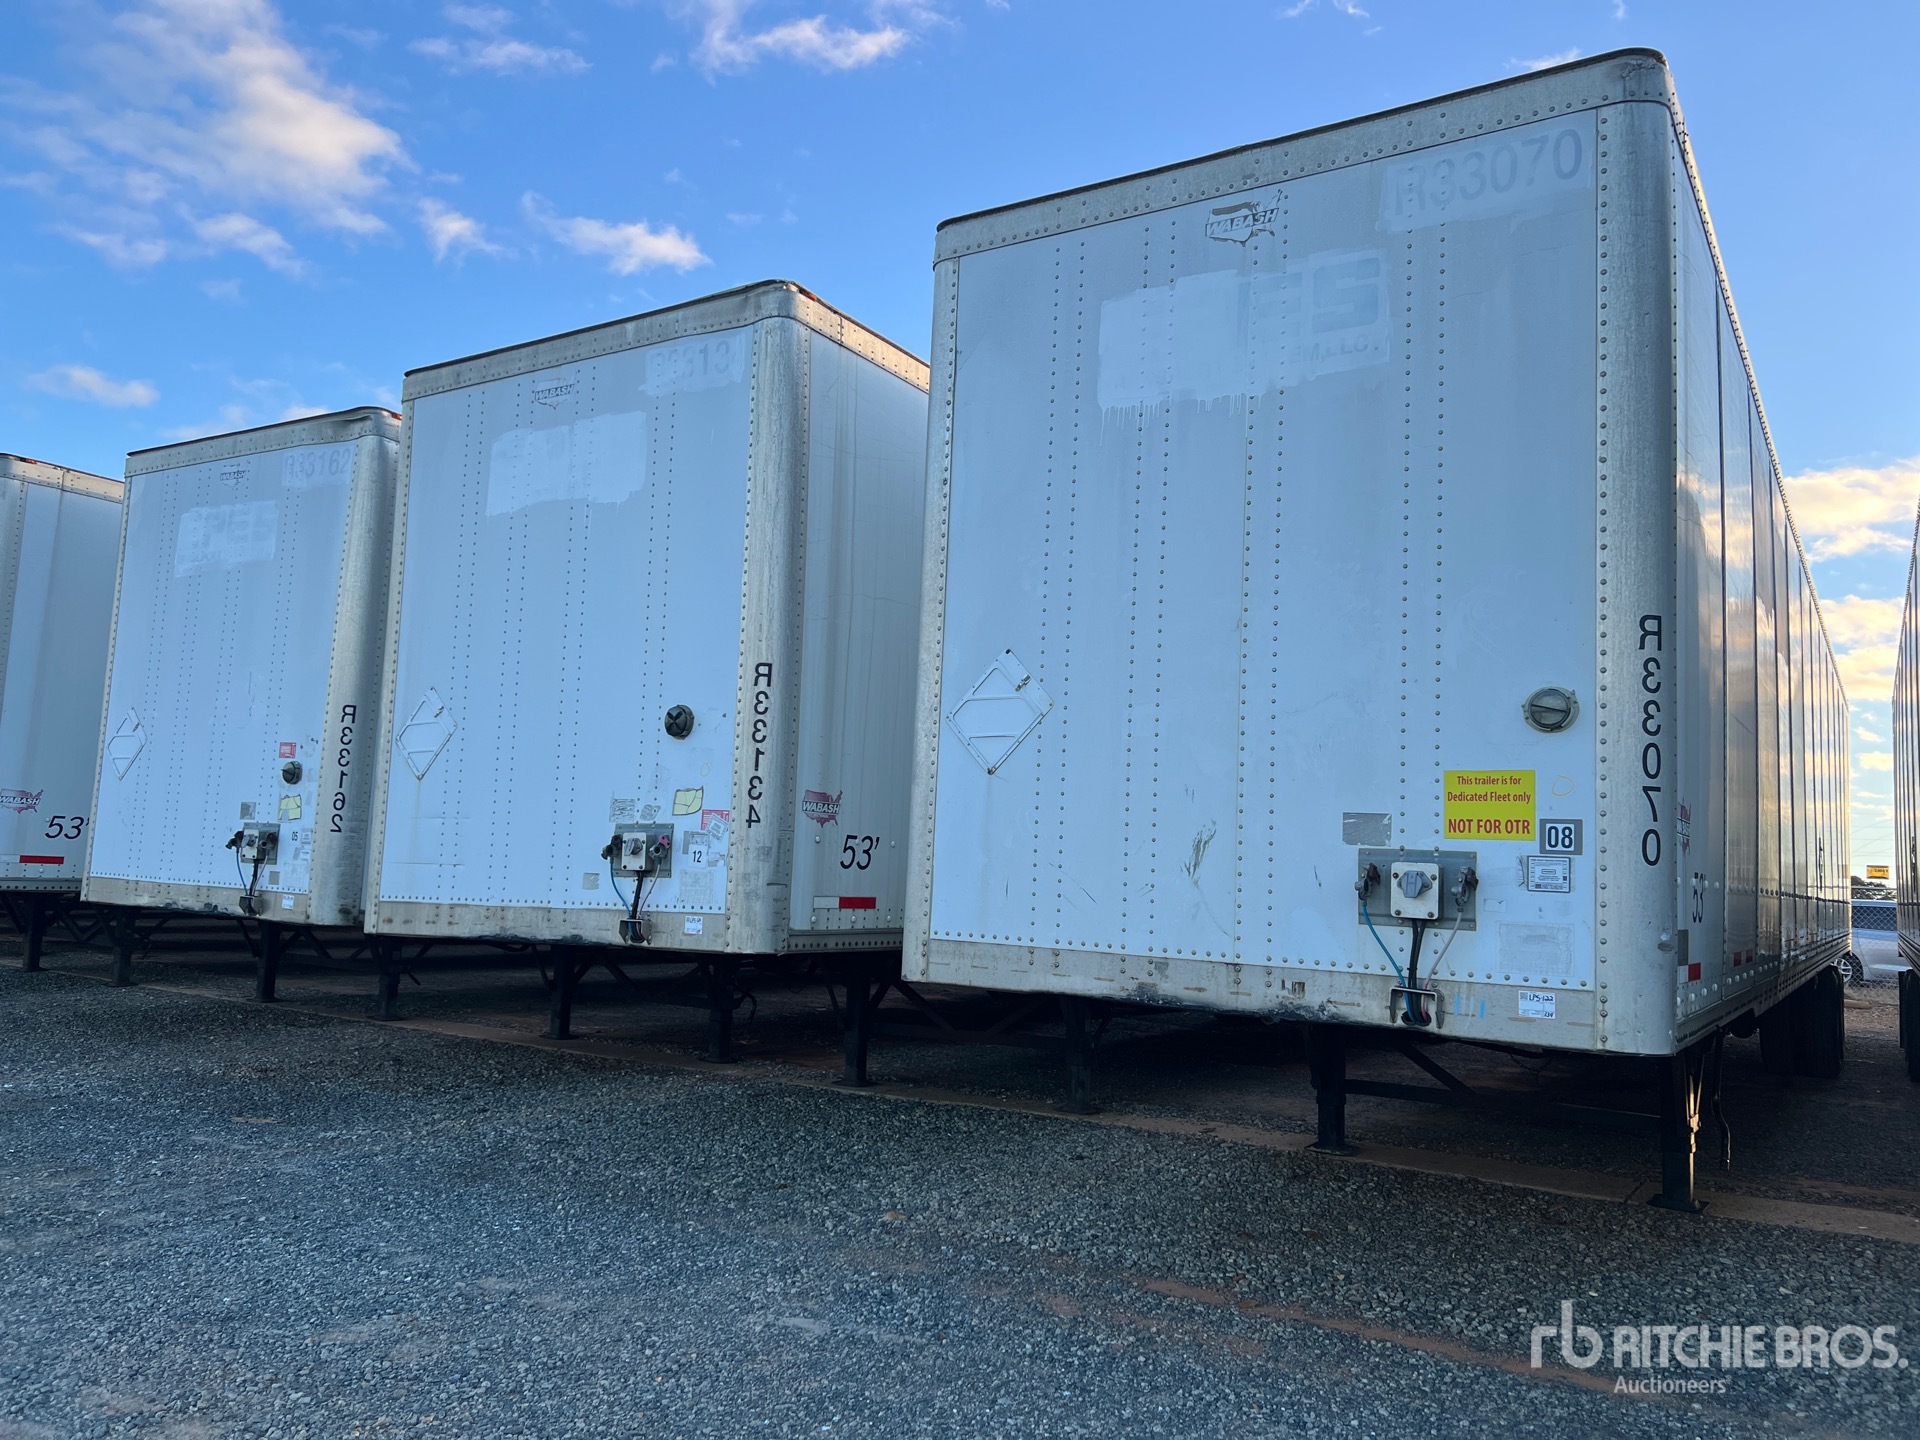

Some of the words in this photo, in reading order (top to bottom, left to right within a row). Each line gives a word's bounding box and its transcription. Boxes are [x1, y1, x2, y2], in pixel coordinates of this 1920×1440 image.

[1395, 129, 1583, 215] R33070
[1207, 208, 1280, 237] WABASH
[535, 384, 575, 401] WABASH
[1456, 775, 1473, 785] This
[1474, 775, 1500, 785] trailer
[1501, 775, 1508, 785] is
[1509, 776, 1522, 785] for
[0, 796, 41, 806] WABASH
[1447, 791, 1488, 802] Dedicated
[1490, 792, 1511, 802] Fleet
[1512, 792, 1532, 804] only
[802, 801, 841, 814] WABASH
[45, 815, 90, 839] 53'
[1448, 818, 1474, 834] NOT
[1476, 819, 1502, 834] FOR
[1504, 819, 1531, 835] OTR
[1547, 825, 1574, 849] 08
[692, 849, 703, 863] 12
[840, 834, 880, 870] 53'
